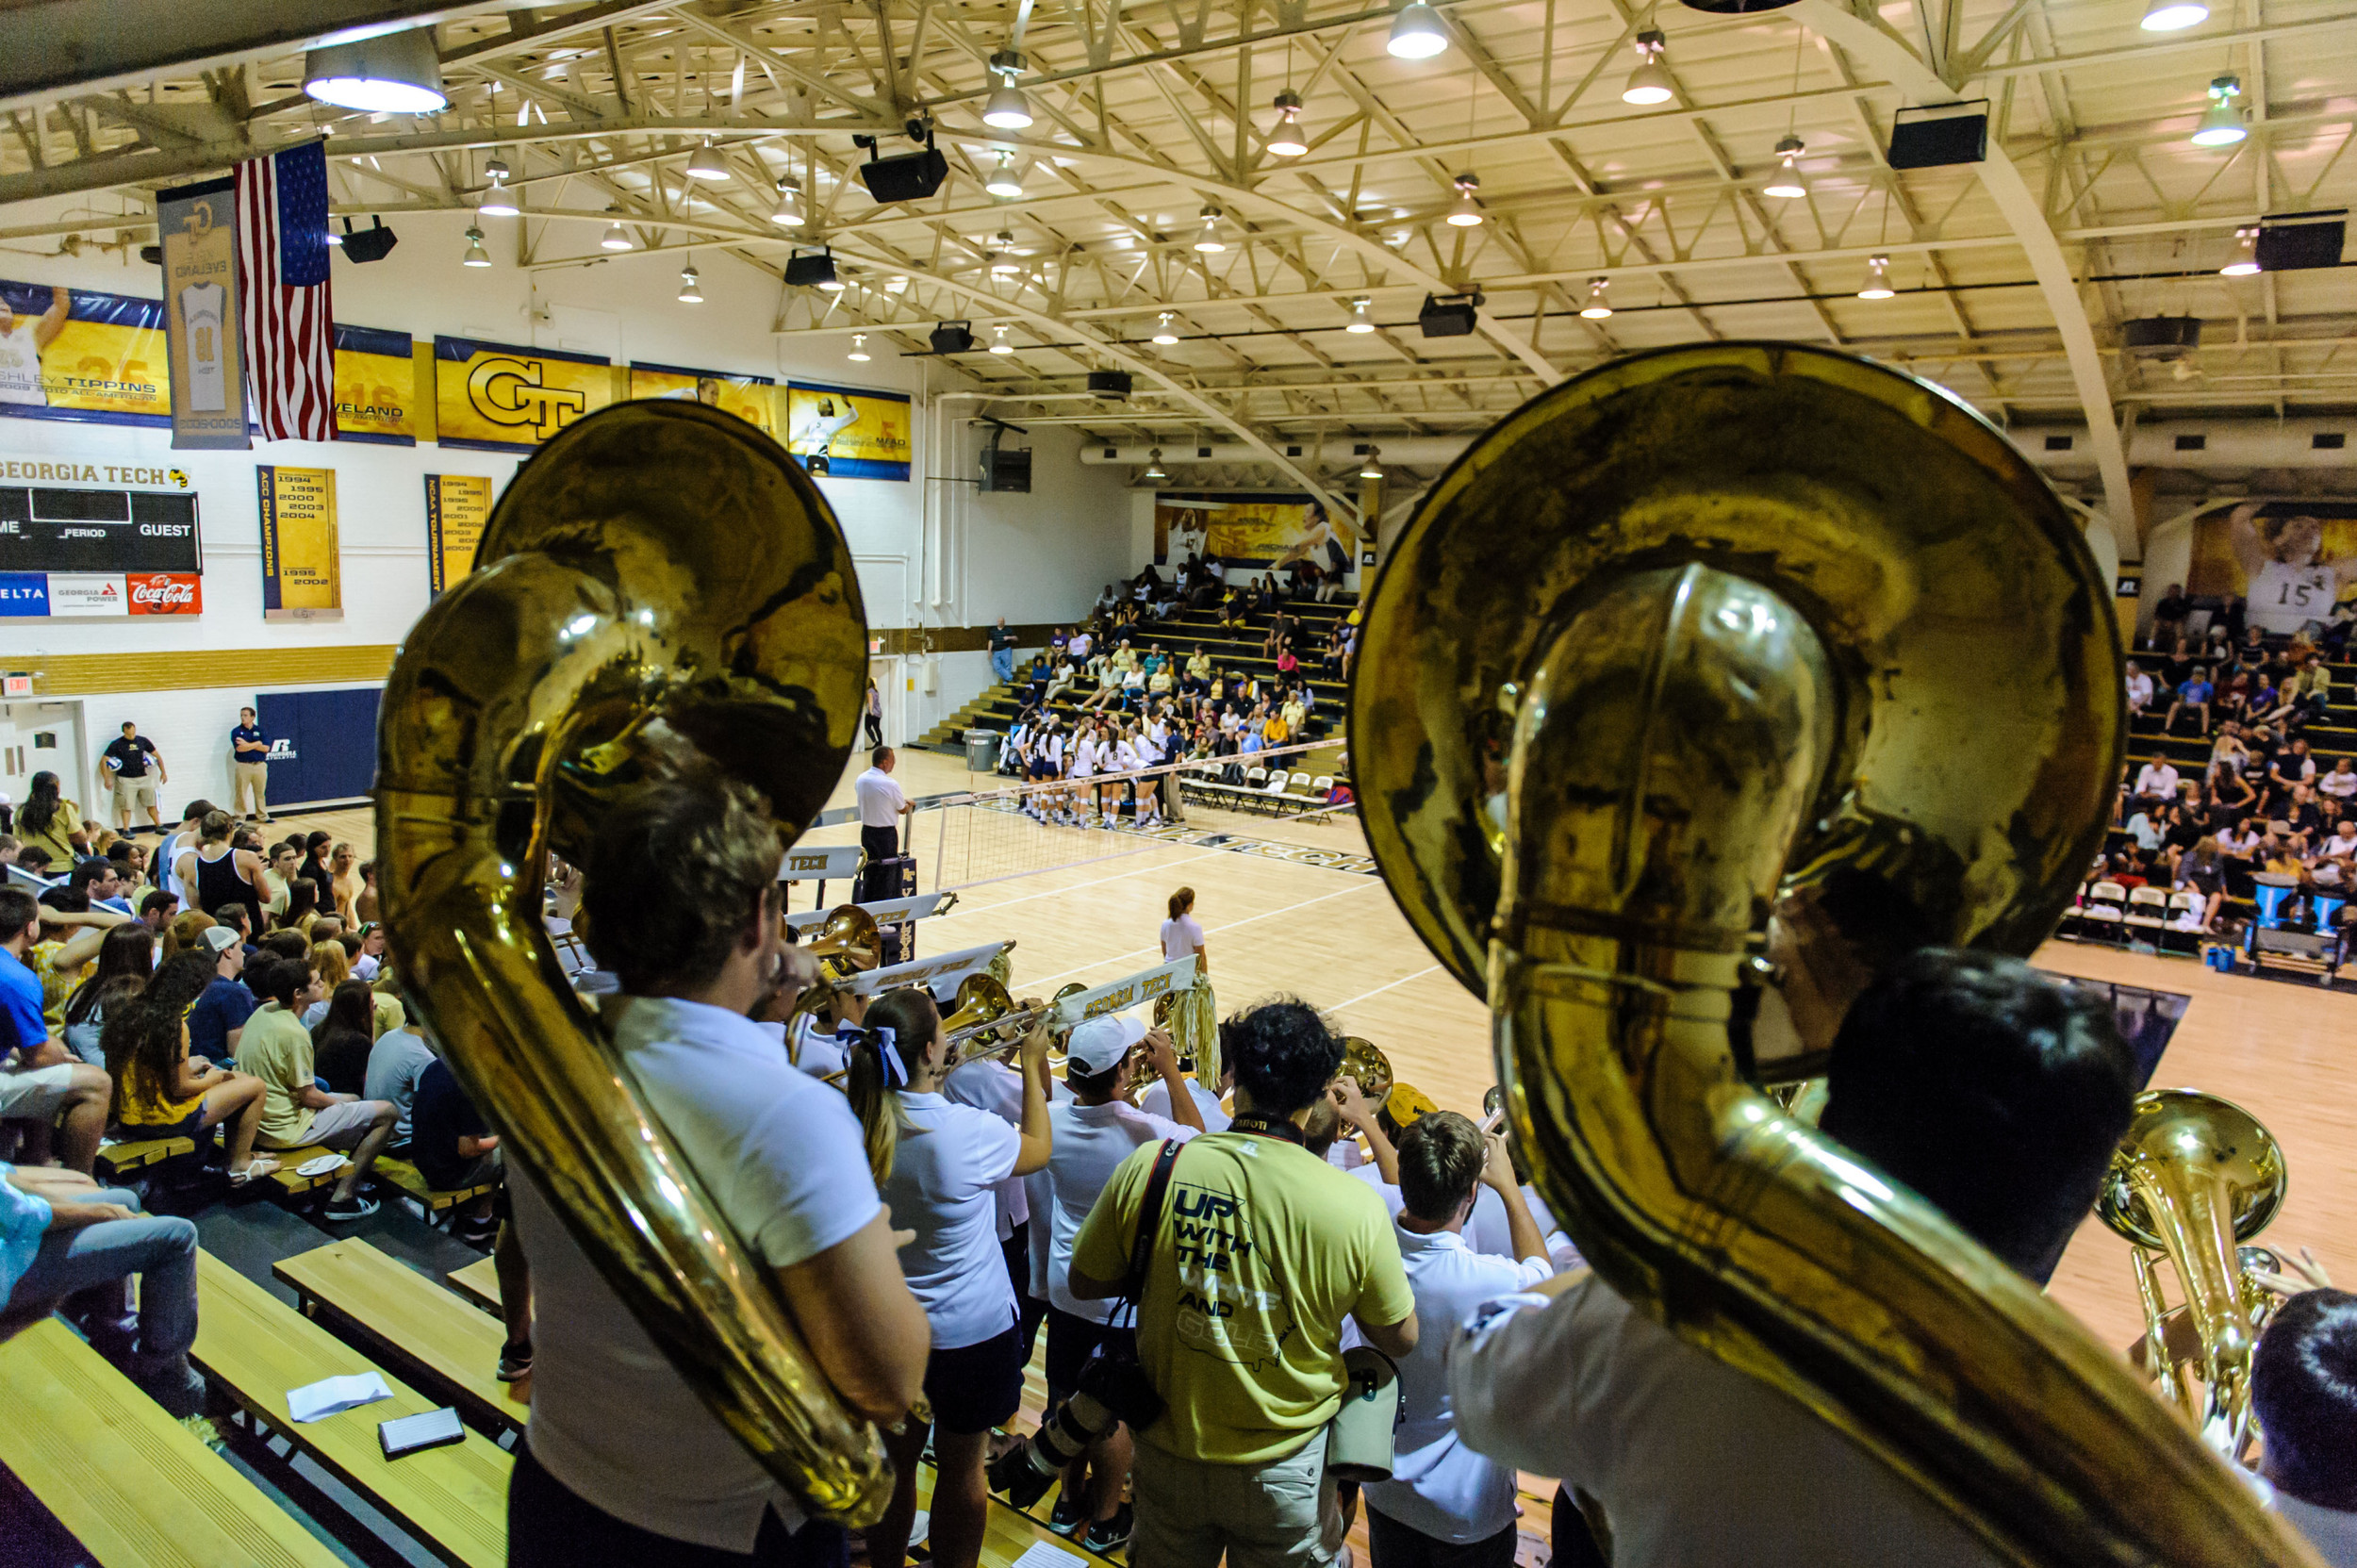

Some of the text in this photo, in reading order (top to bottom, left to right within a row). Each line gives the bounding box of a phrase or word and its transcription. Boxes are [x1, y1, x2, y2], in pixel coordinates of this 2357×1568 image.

[0, 371, 156, 394] SHLEY TIPPINS
[468, 357, 585, 440] GT
[335, 403, 404, 418] VELAND
[103, 466, 165, 485] TECH
[0, 520, 20, 534] ME
[64, 529, 107, 537] PERIOD
[140, 523, 190, 537] GUEST
[261, 471, 274, 577] ACC CHAMPIONS
[430, 512, 441, 592] TOURNAMENT
[0, 588, 44, 599] ELTA
[2278, 583, 2311, 607] 15
[9, 678, 27, 691] EXIT
[1112, 751, 1118, 761] 8
[789, 854, 829, 871] TECH
[1082, 972, 1174, 1021] GEORGIA TECH
[1236, 1118, 1267, 1131] anon
[1174, 1189, 1237, 1221] UP
[1173, 1220, 1253, 1258] WITH
[1177, 1245, 1231, 1273] THE
[1178, 1266, 1282, 1312] WHITE
[1177, 1291, 1234, 1318] AND
